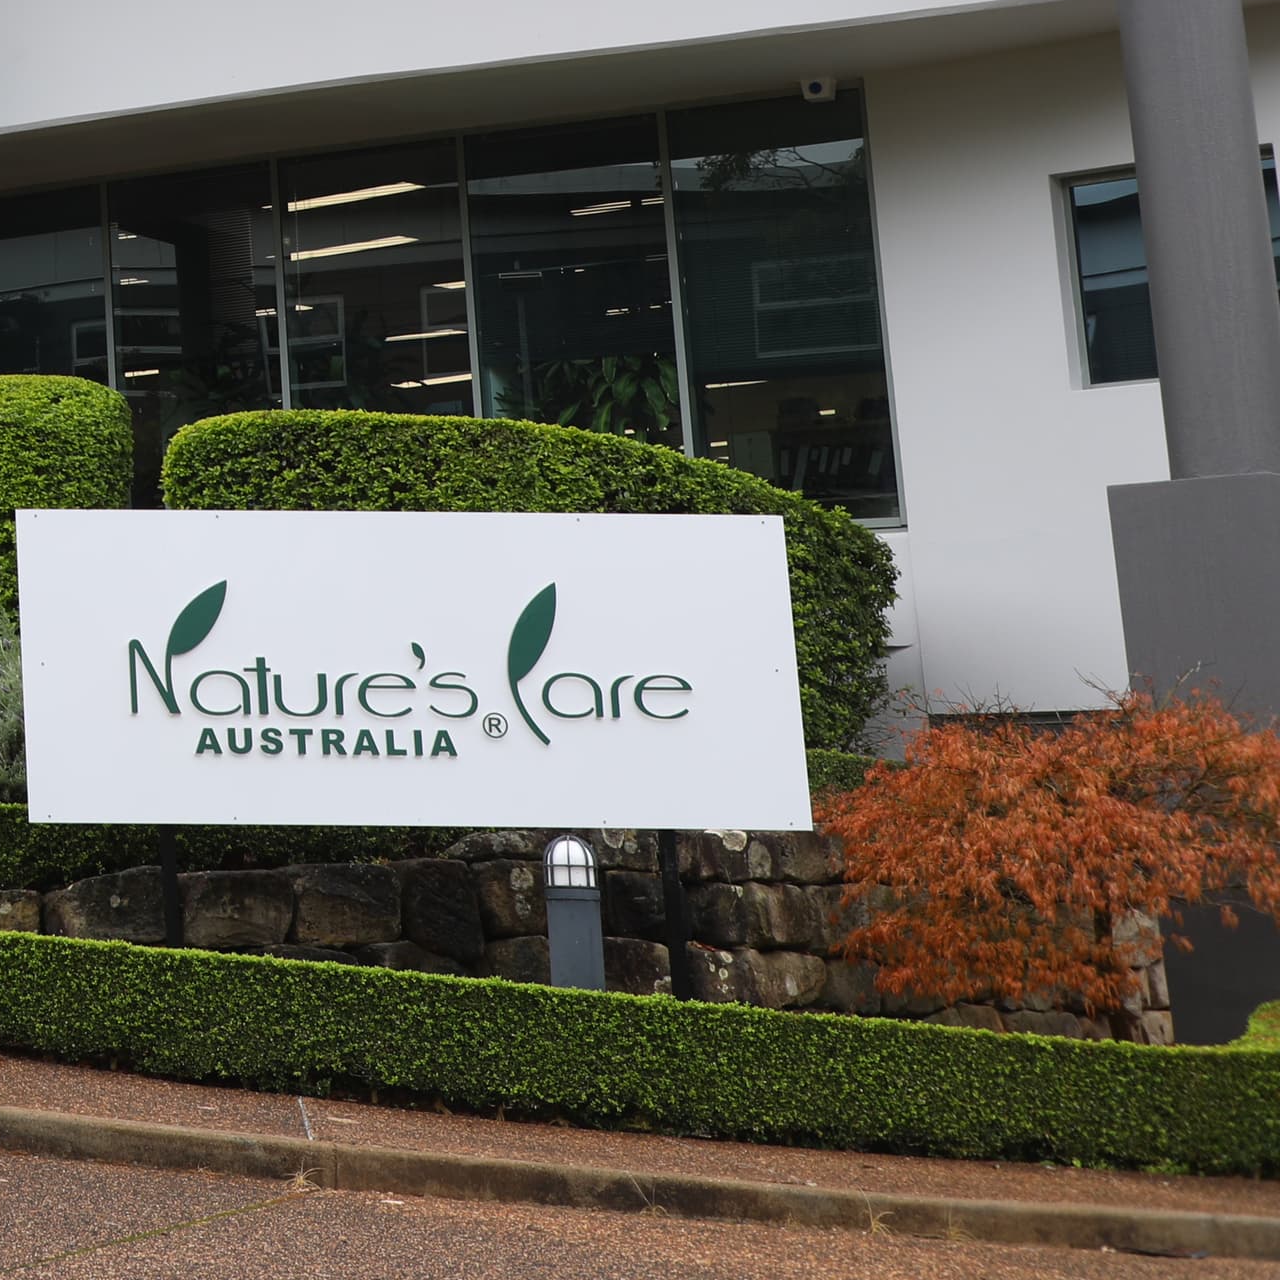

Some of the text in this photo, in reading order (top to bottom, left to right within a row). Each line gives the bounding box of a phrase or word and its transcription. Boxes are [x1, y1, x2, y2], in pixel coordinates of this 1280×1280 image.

[127, 578, 480, 720] Nature's
[506, 581, 694, 748] Care
[194, 726, 459, 758] AUSTRALIA
